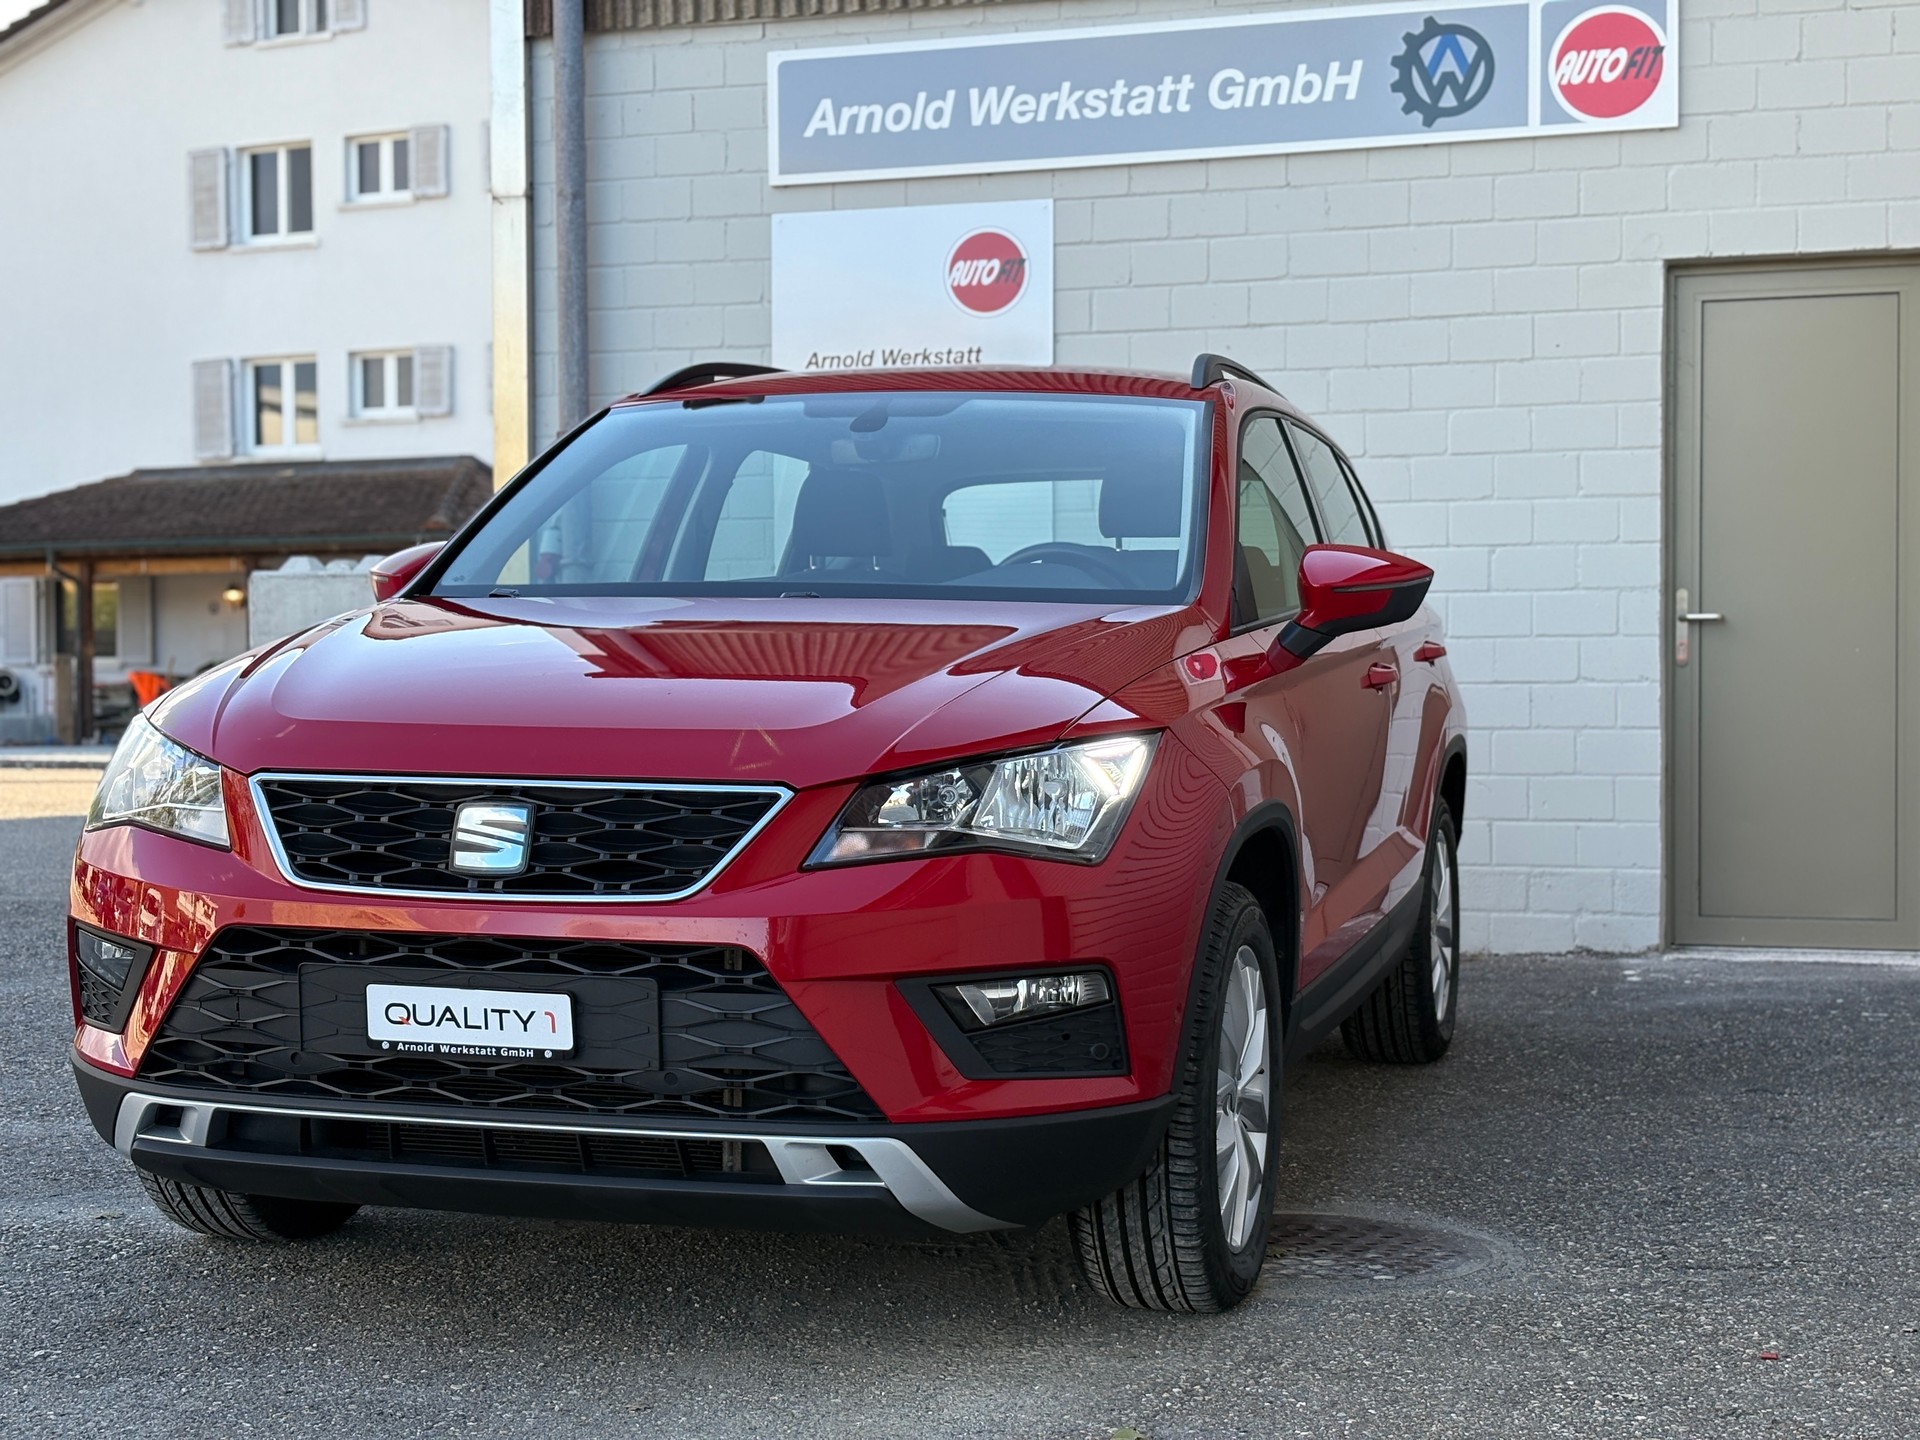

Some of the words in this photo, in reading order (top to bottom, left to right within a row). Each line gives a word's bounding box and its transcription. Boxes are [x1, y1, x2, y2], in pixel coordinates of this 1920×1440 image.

[803, 89, 956, 138] Arnold
[968, 74, 1195, 127] Werkstatt
[1207, 59, 1364, 110] GmbH
[805, 350, 874, 369] Arnold
[882, 346, 982, 366] Werkstatt
[384, 1002, 536, 1032] QUALITY
[544, 1011, 556, 1034] 1
[397, 1042, 434, 1053] Arnold
[440, 1044, 497, 1056] Werkstatt
[500, 1047, 534, 1058] GmbH
